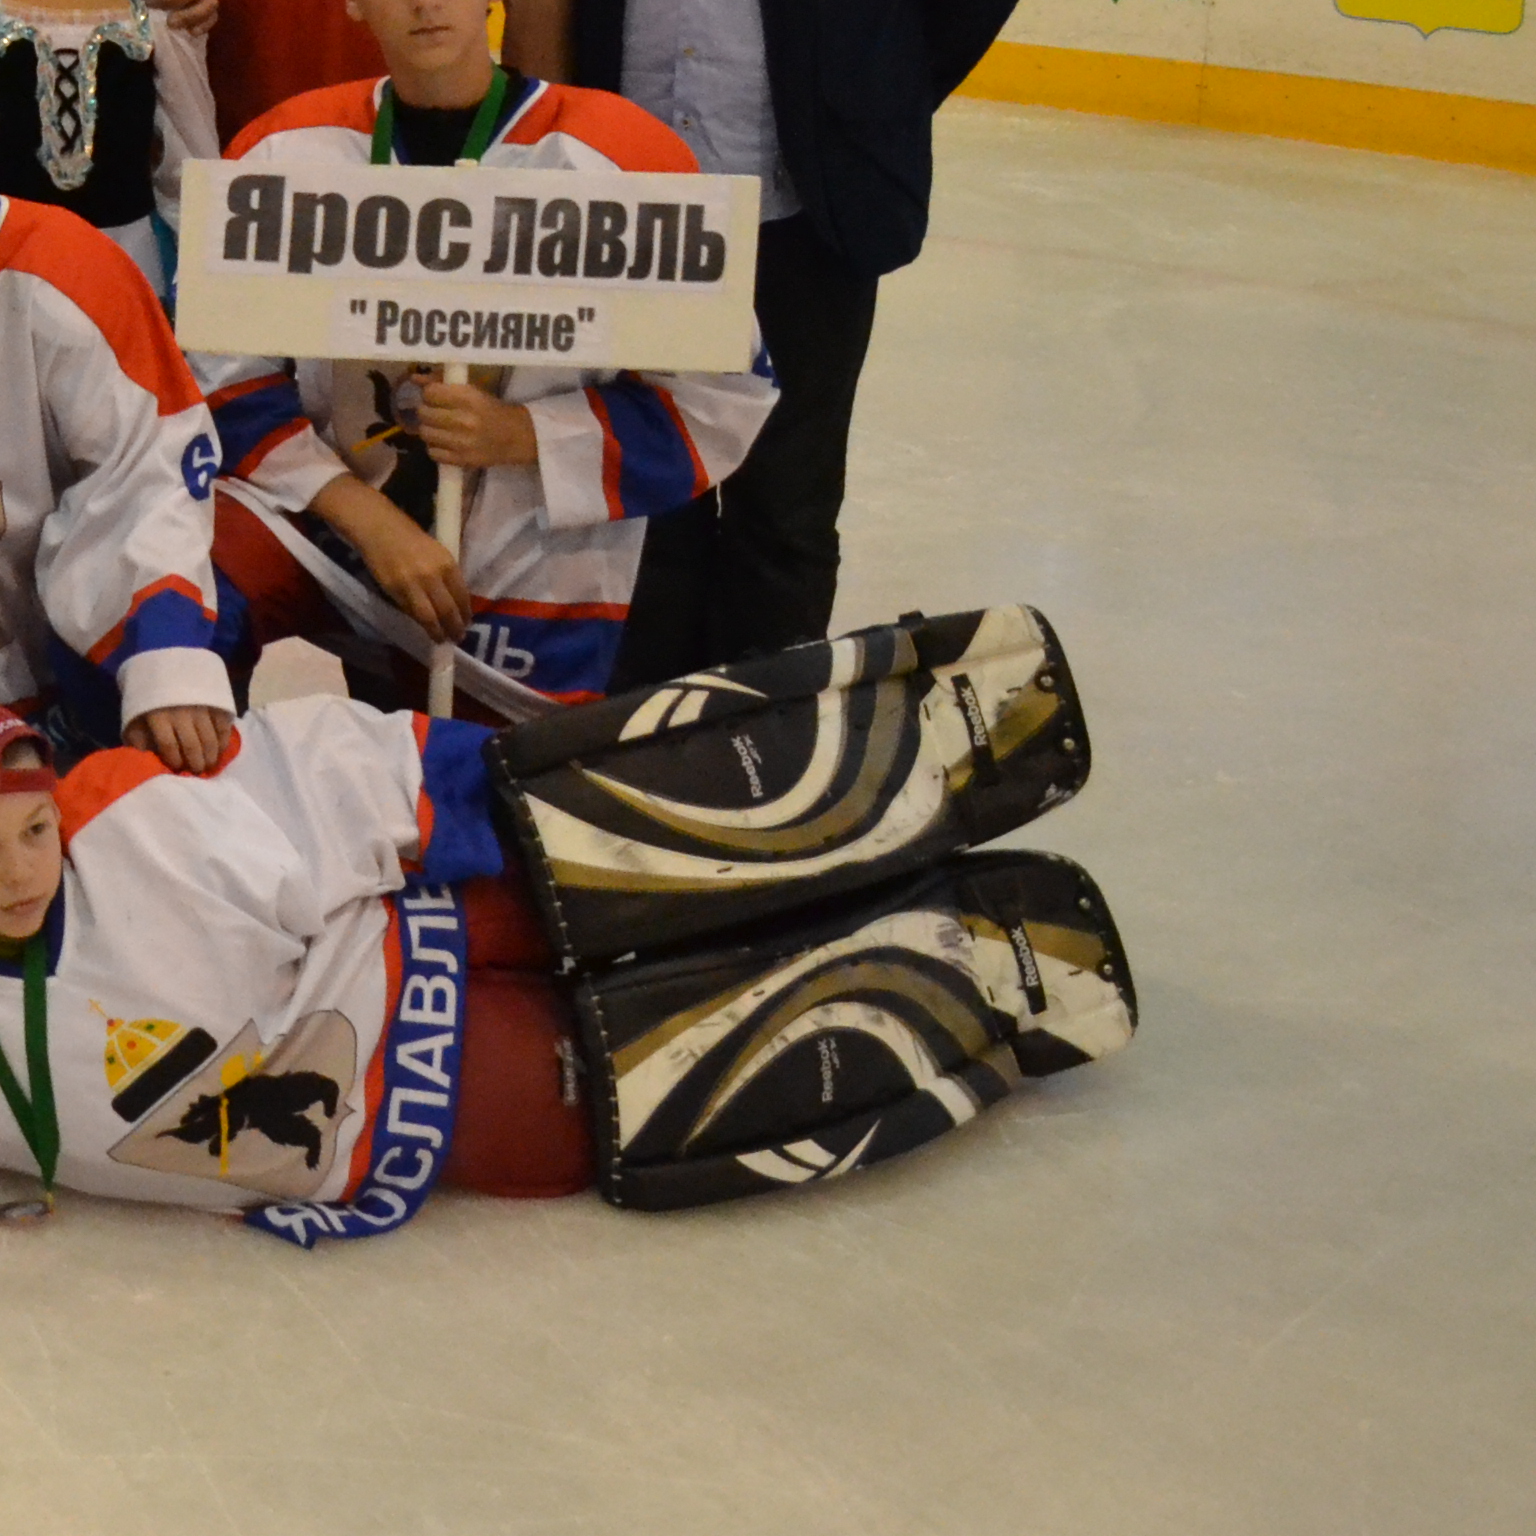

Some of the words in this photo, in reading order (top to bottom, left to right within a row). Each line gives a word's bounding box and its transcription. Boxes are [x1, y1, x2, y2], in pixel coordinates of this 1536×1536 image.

[223, 174, 726, 284] Ярославль
[348, 299, 595, 352] "Россияне"
[960, 686, 989, 748] Reebok
[731, 735, 764, 799] Reebok
[1011, 925, 1040, 988] Reebok
[819, 1038, 835, 1103] Reebok
